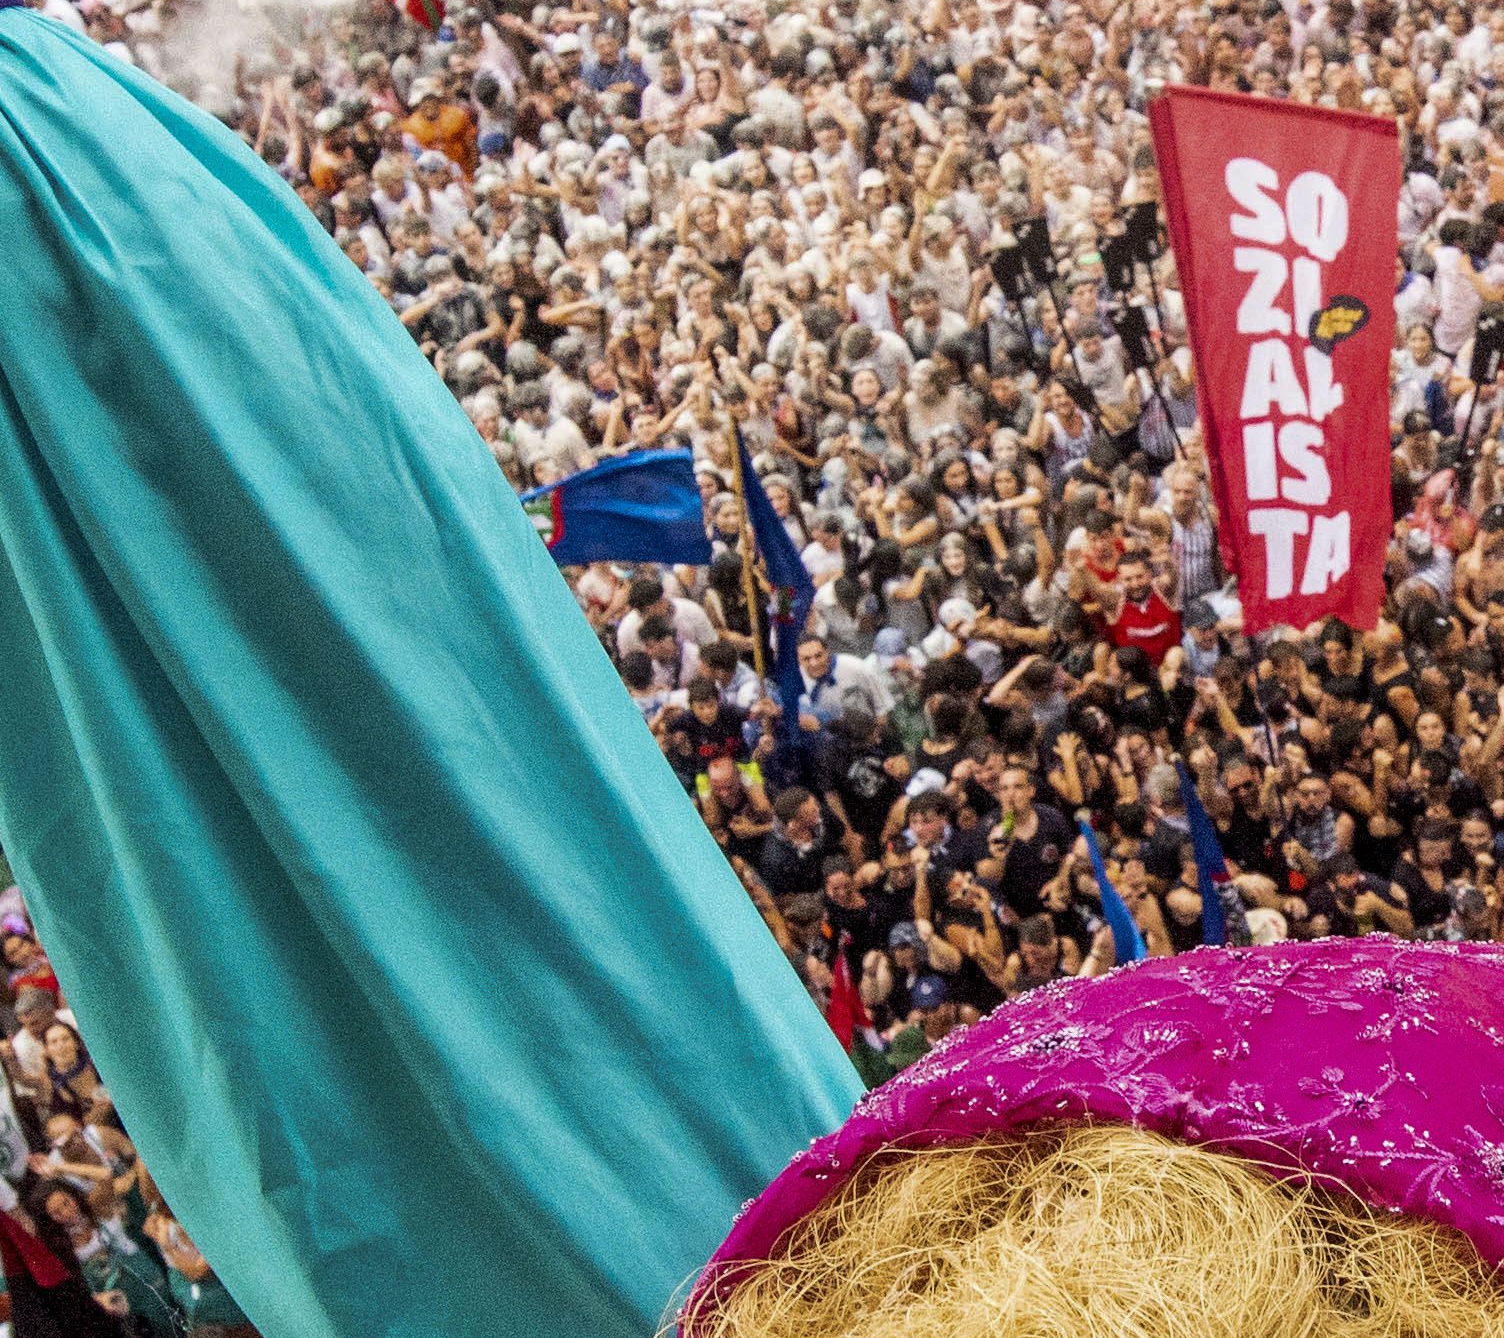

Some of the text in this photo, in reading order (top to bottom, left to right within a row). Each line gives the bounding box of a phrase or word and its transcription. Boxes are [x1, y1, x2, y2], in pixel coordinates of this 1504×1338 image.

[1224, 157, 1349, 262] SO
[1234, 245, 1322, 340] ZI
[1239, 337, 1344, 422] AL
[1240, 421, 1331, 506] IS
[1247, 507, 1351, 601] TA
